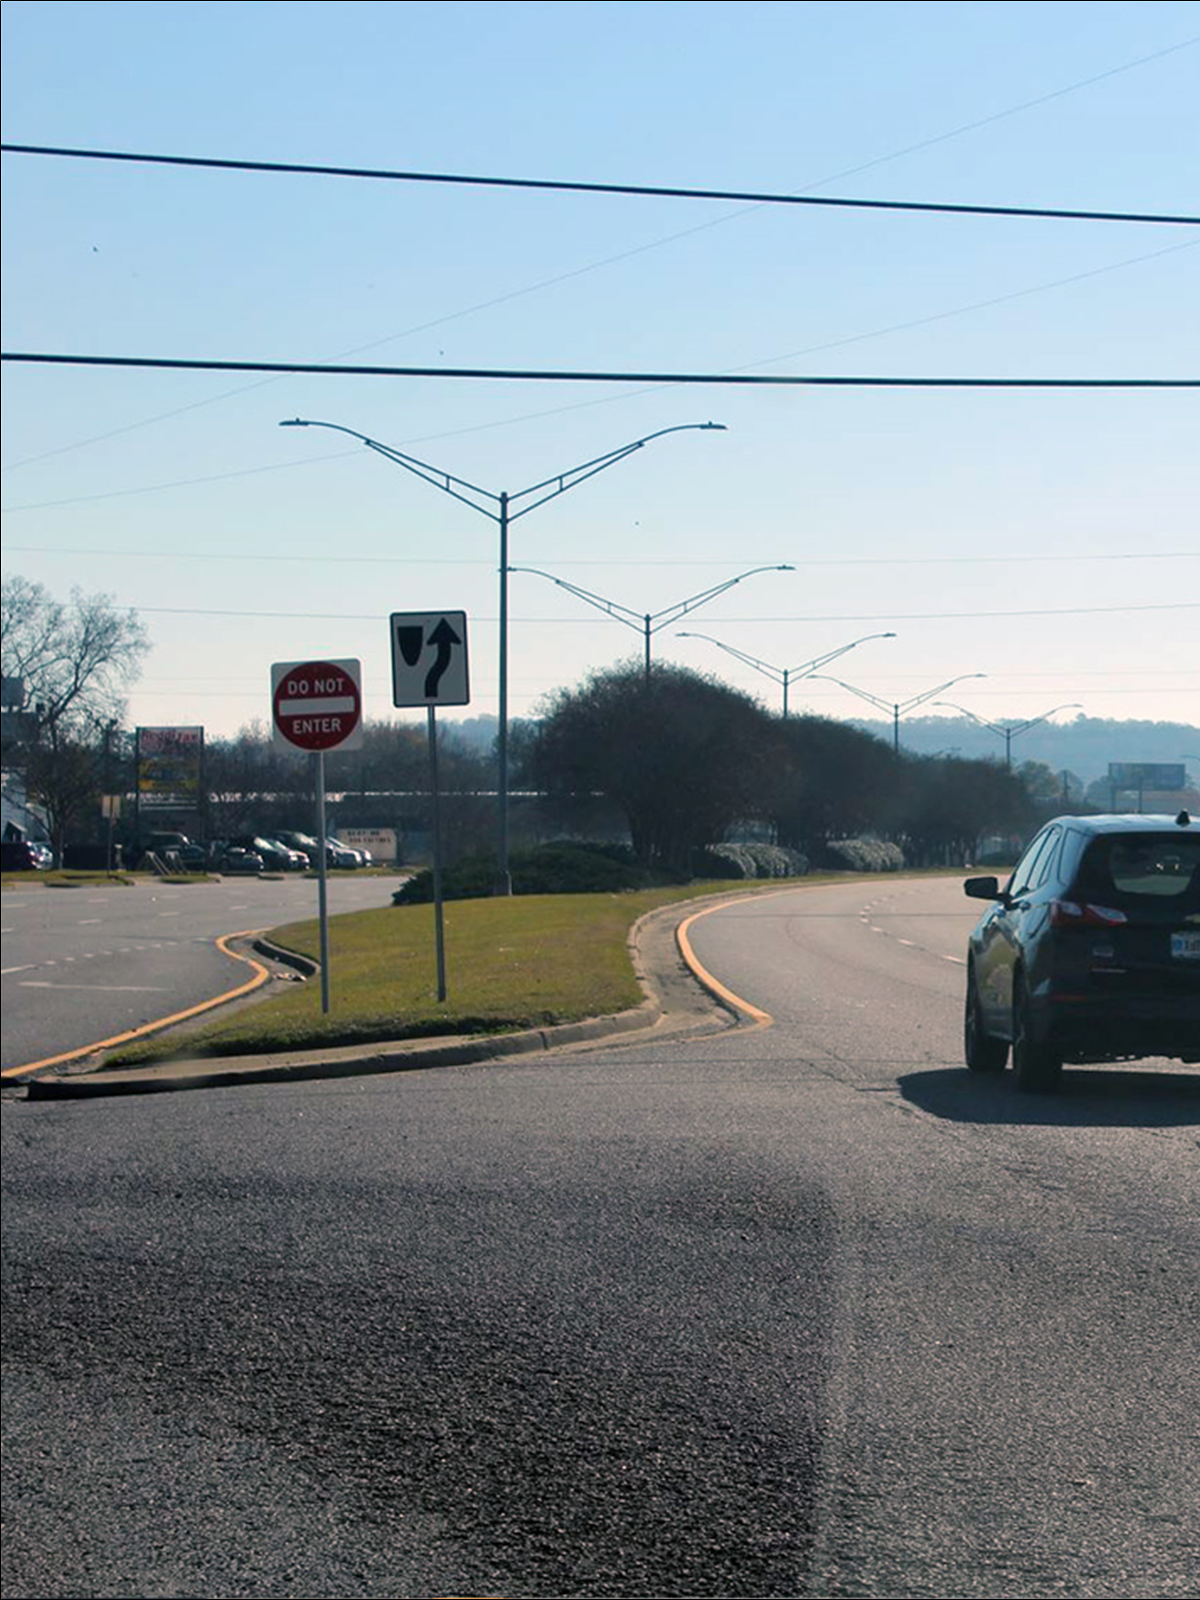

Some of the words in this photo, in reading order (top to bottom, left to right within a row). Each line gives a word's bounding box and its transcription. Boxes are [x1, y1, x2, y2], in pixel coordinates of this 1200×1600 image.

[288, 680, 309, 695] DO
[314, 678, 344, 693] NOT
[293, 717, 341, 734] ENTER
